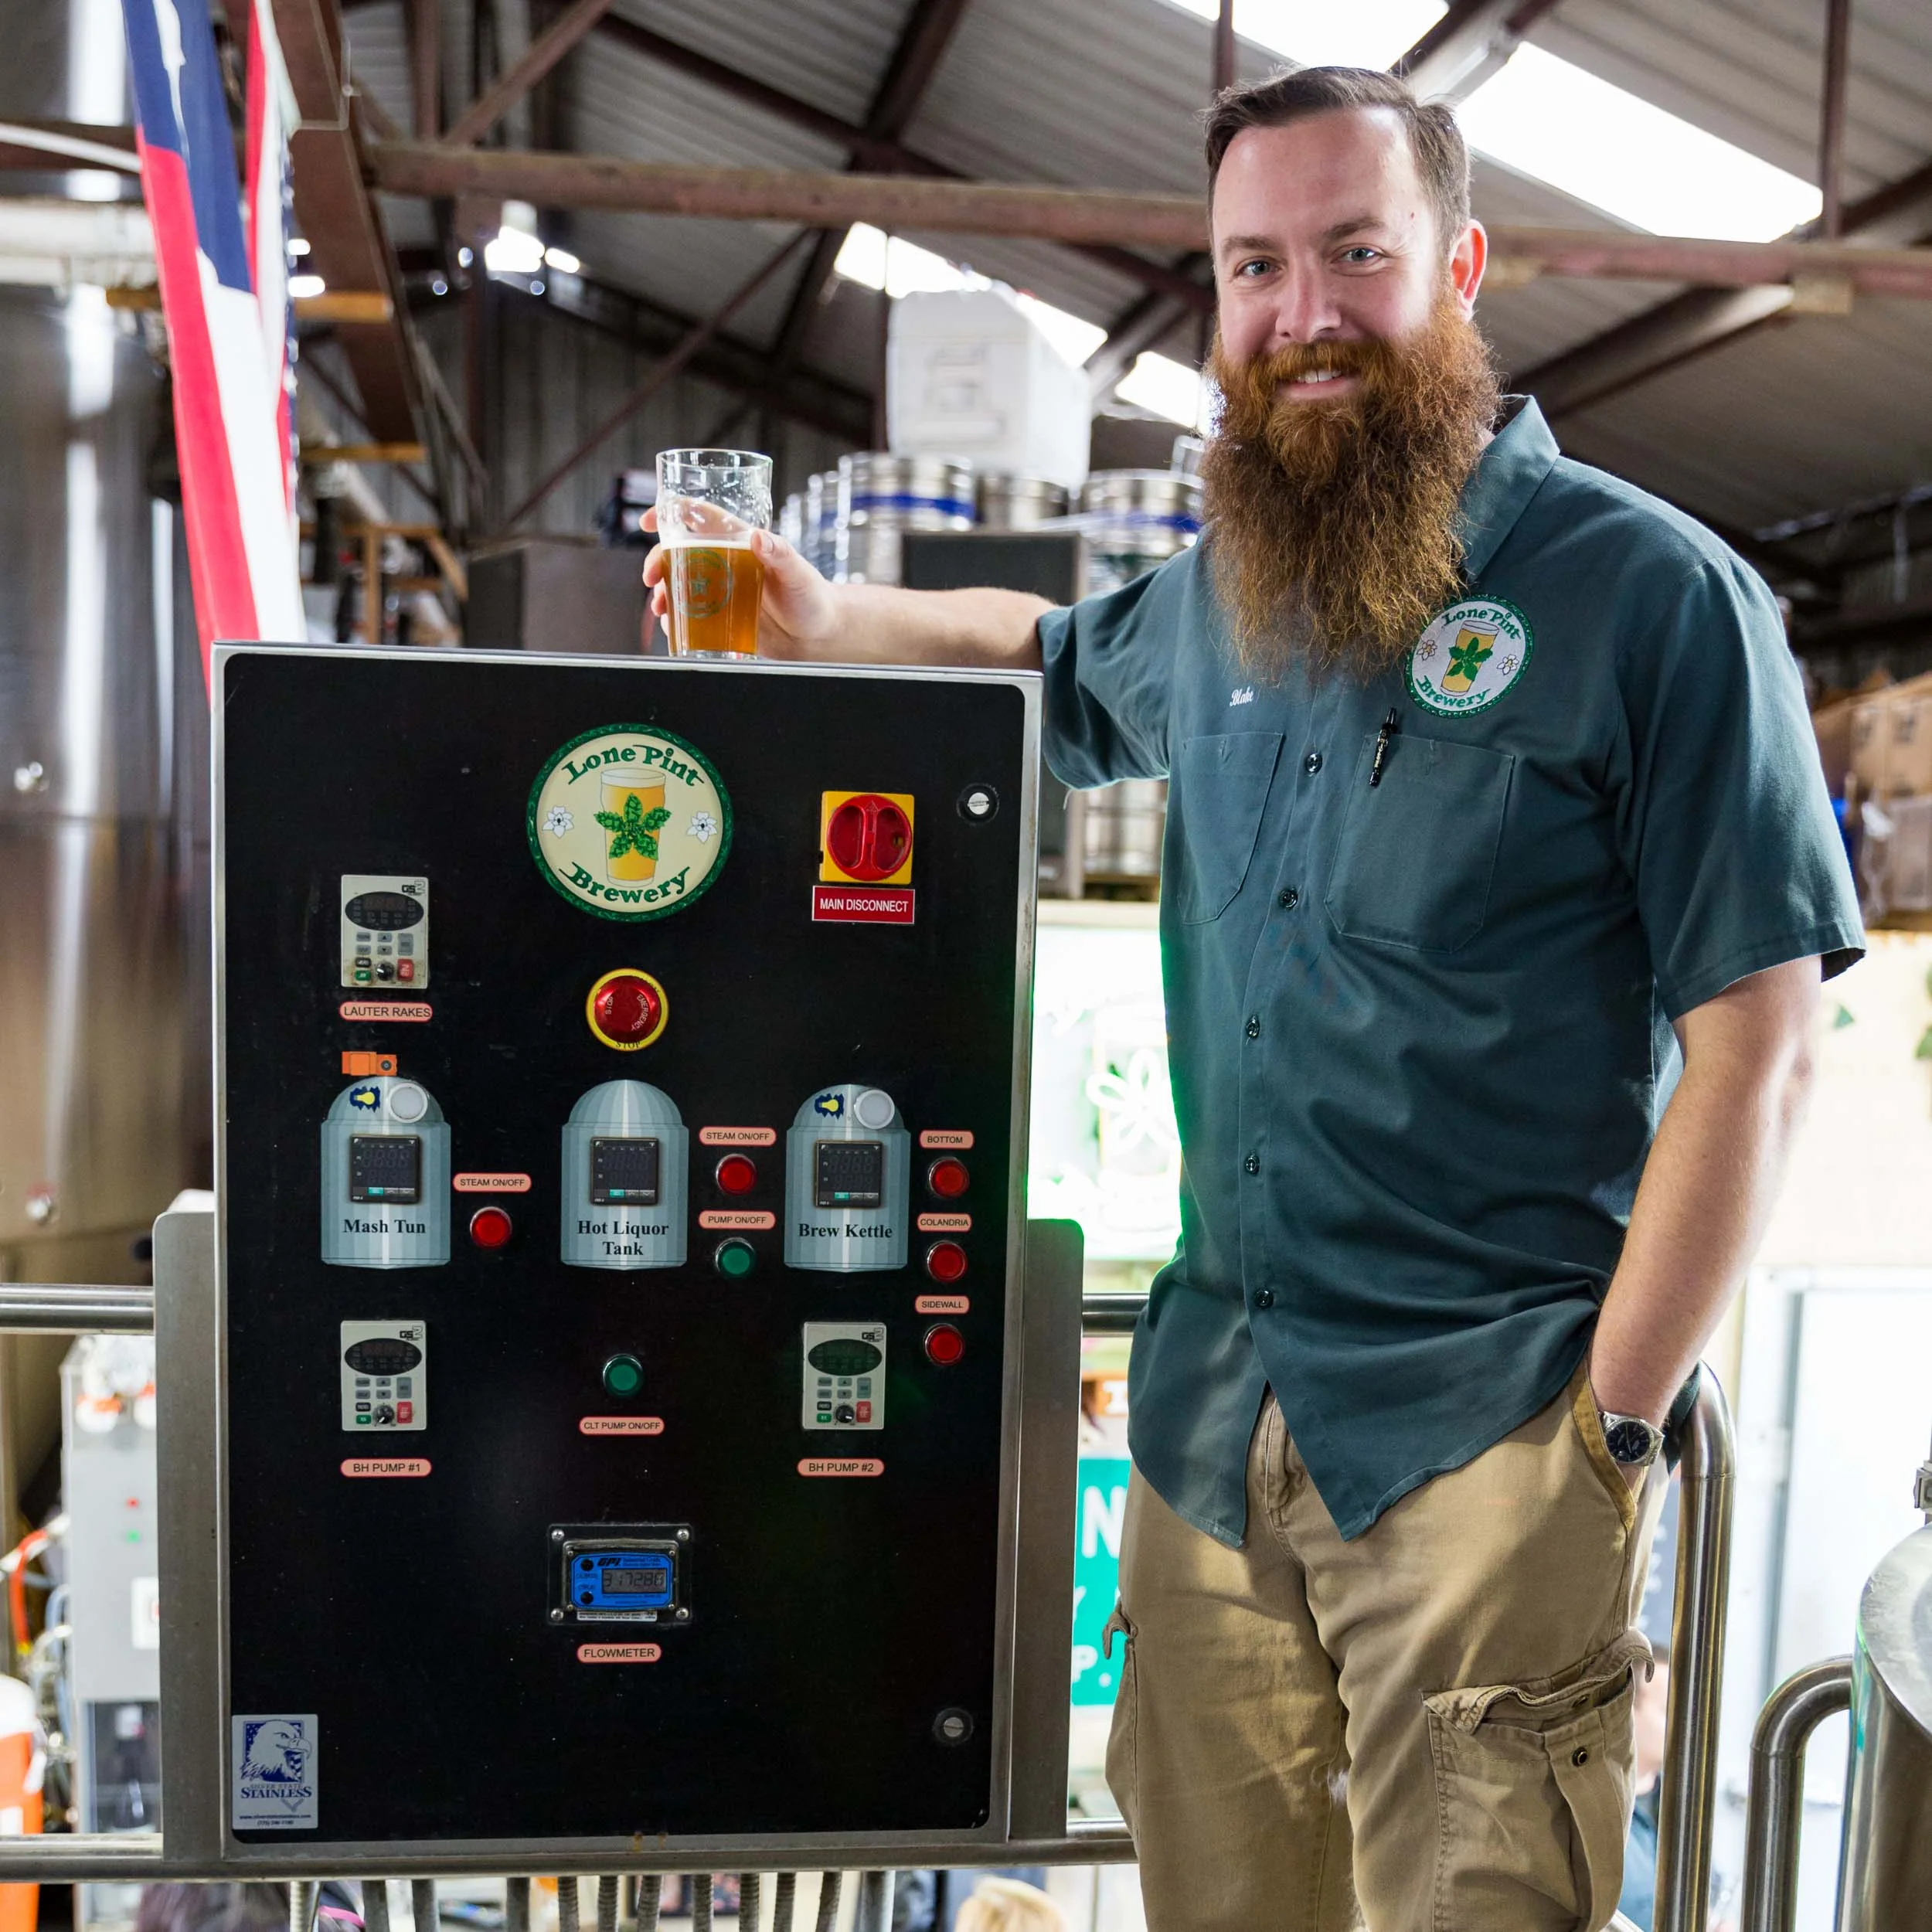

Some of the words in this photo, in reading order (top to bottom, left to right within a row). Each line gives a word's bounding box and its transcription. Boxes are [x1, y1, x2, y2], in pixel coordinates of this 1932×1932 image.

[1442, 608, 1488, 627] Lone
[1488, 608, 1522, 640] Pint
[1230, 686, 1254, 707] Blake
[1416, 675, 1491, 709] Brewery
[561, 747, 636, 785] Lone
[632, 744, 705, 787] Pint
[559, 862, 690, 903] Brewery
[819, 897, 844, 912] MAIN
[845, 898, 909, 913] DISCONNECT
[344, 1007, 389, 1016] LAUTER
[392, 1007, 430, 1017] RAKES
[605, 996, 614, 1015] STOP
[631, 994, 649, 1032] EMERGENCY
[706, 1131, 735, 1141] STEAM
[737, 1132, 770, 1141] ON/OFF
[492, 1179, 526, 1187] ON/OFF
[343, 1219, 389, 1233] Mash
[394, 1219, 427, 1233] Tun
[708, 1216, 733, 1224] PUMP
[734, 1216, 767, 1224] ON/OFF
[920, 1218, 969, 1226] COLANDRIA
[577, 1220, 607, 1235] Hot
[613, 1221, 669, 1238] Liquor
[799, 1223, 839, 1237] Brew
[845, 1223, 893, 1238] Kettle
[602, 1241, 644, 1256] Tank
[583, 1421, 600, 1430] CLT
[628, 1422, 661, 1430] ON/OFF
[352, 1463, 369, 1472] BH
[372, 1463, 406, 1472] PUMP
[408, 1463, 420, 1472] #1
[808, 1463, 824, 1472] BH
[827, 1463, 859, 1472] PUMP
[861, 1463, 874, 1472] #2
[584, 1648, 655, 1658] FLOWMETER
[240, 1786, 312, 1798] STAINLESS
